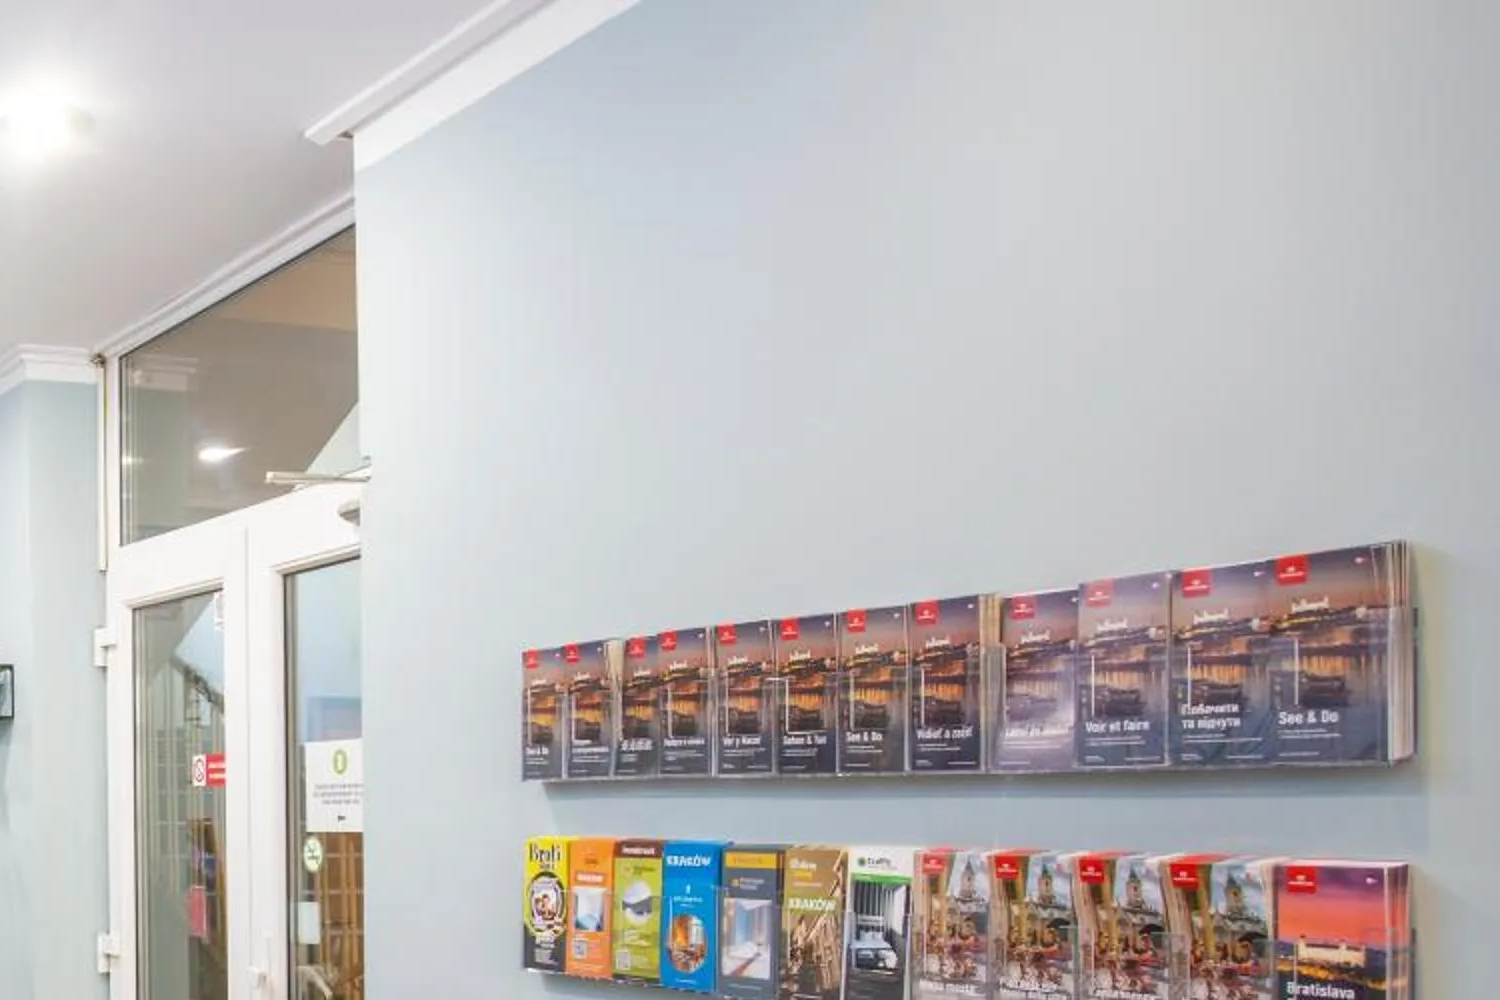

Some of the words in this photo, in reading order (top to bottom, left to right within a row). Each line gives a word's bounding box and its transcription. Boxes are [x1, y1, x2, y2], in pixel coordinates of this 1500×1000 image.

[1278, 711, 1304, 725] See
[1321, 709, 1339, 723] Do
[1286, 981, 1356, 1000] Bratislava
